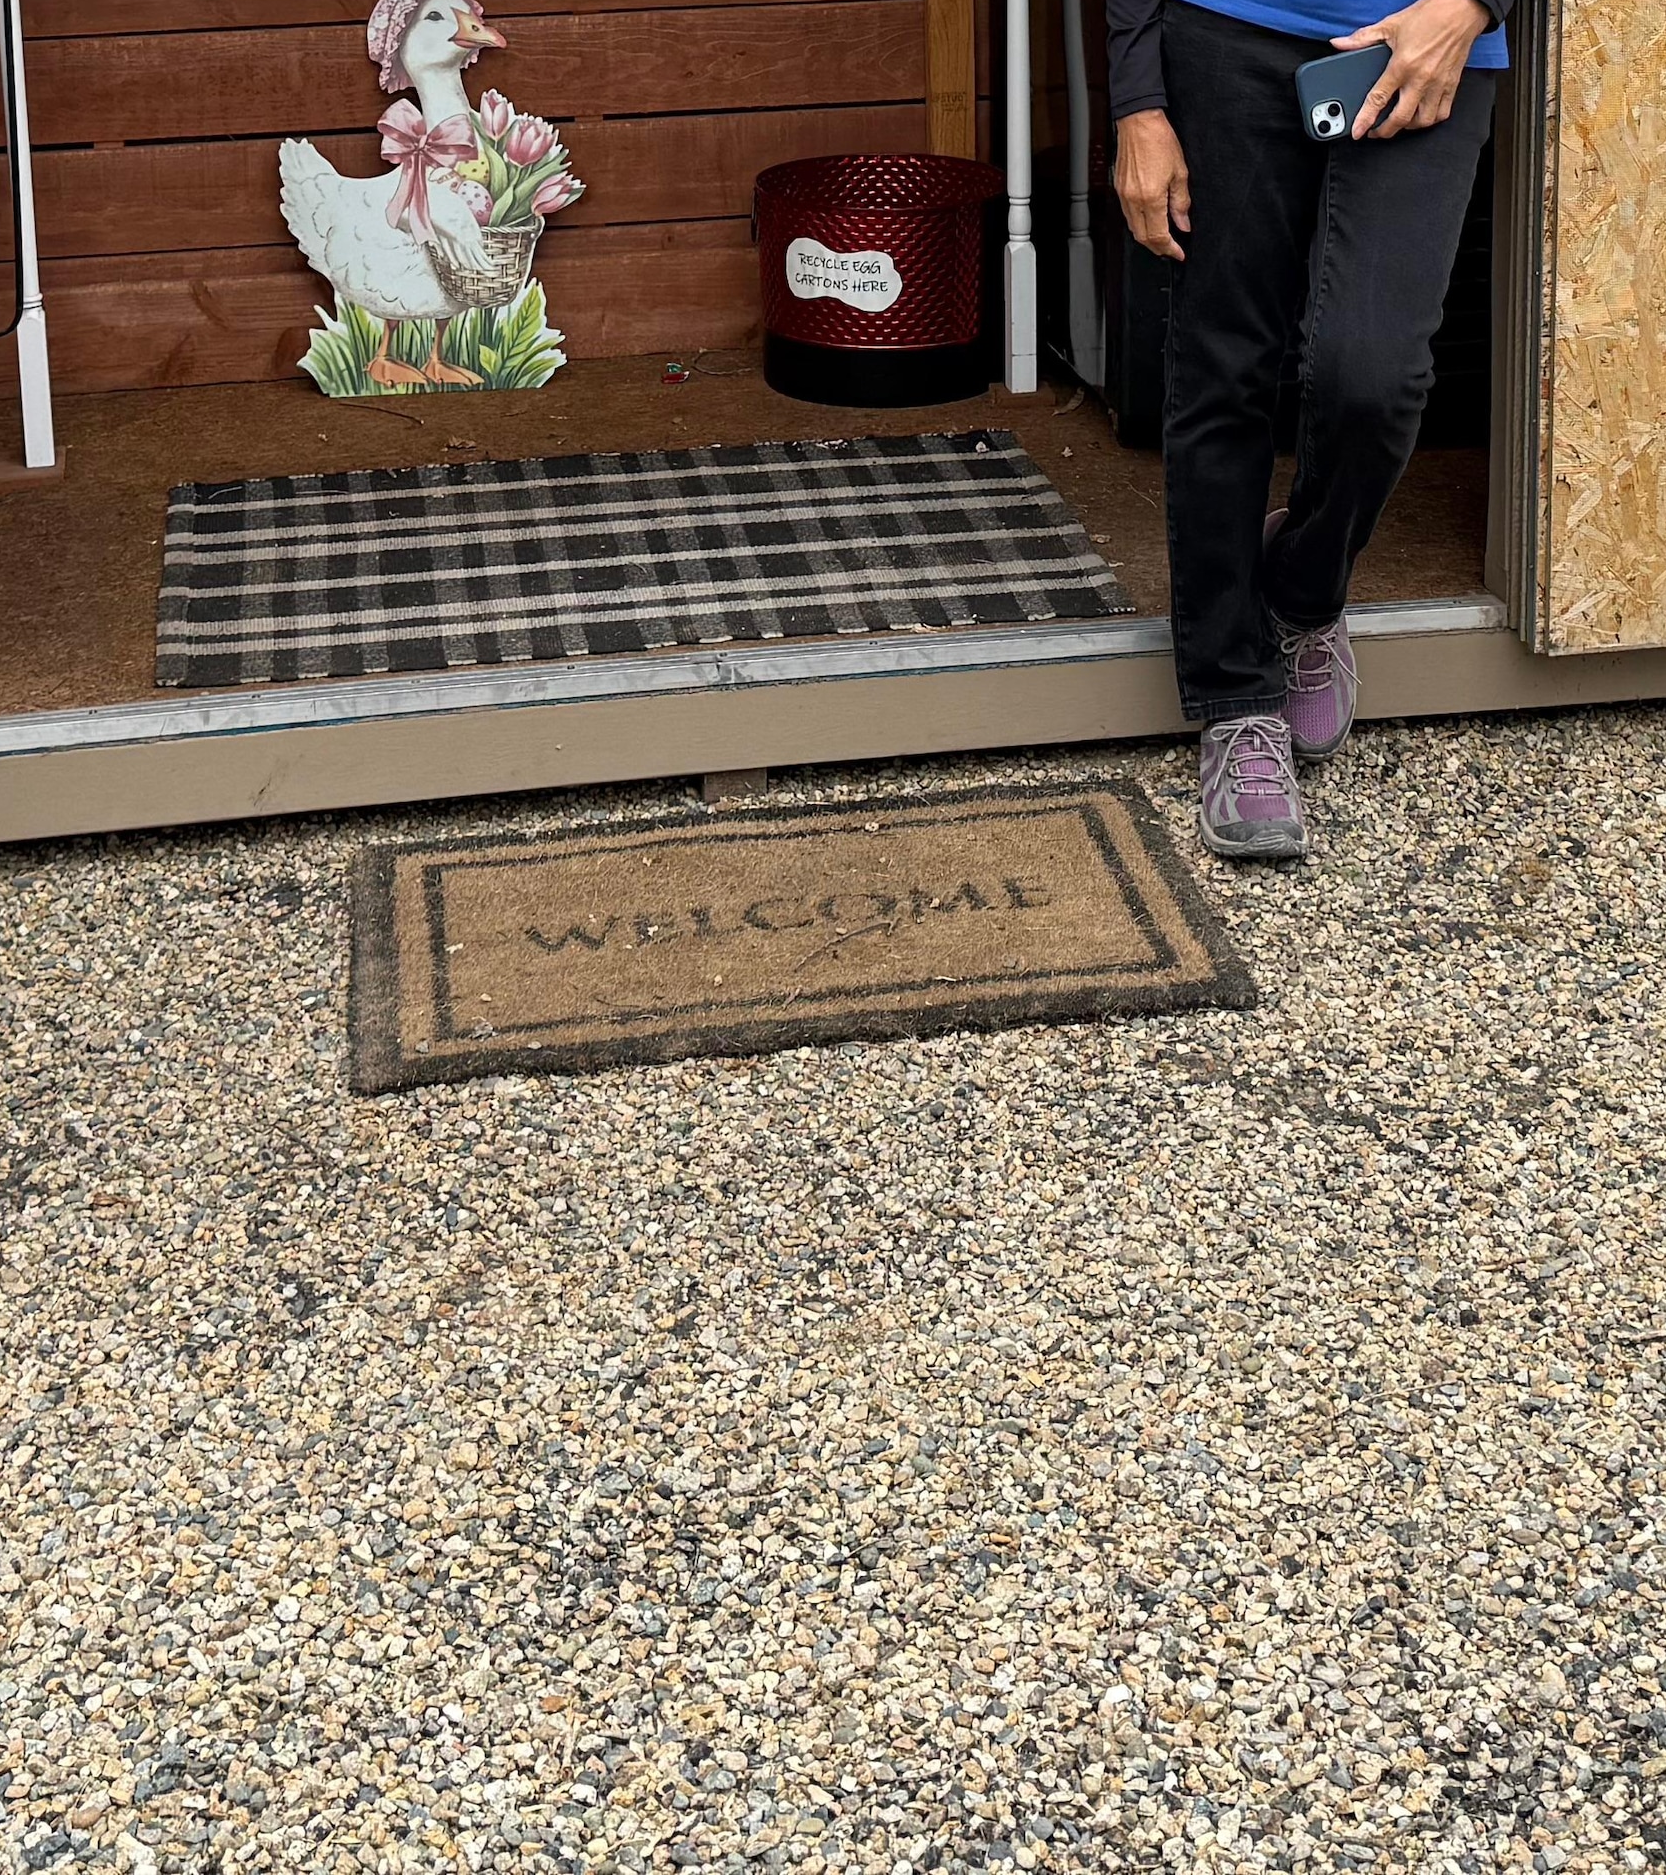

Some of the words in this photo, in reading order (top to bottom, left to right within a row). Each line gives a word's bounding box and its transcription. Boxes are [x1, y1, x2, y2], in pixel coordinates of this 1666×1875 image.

[798, 252, 849, 271] RECYCLE
[852, 261, 881, 274] EGG
[795, 273, 849, 291] CARTONS
[852, 279, 888, 293] HERE
[525, 878, 1049, 953] WELCOME
